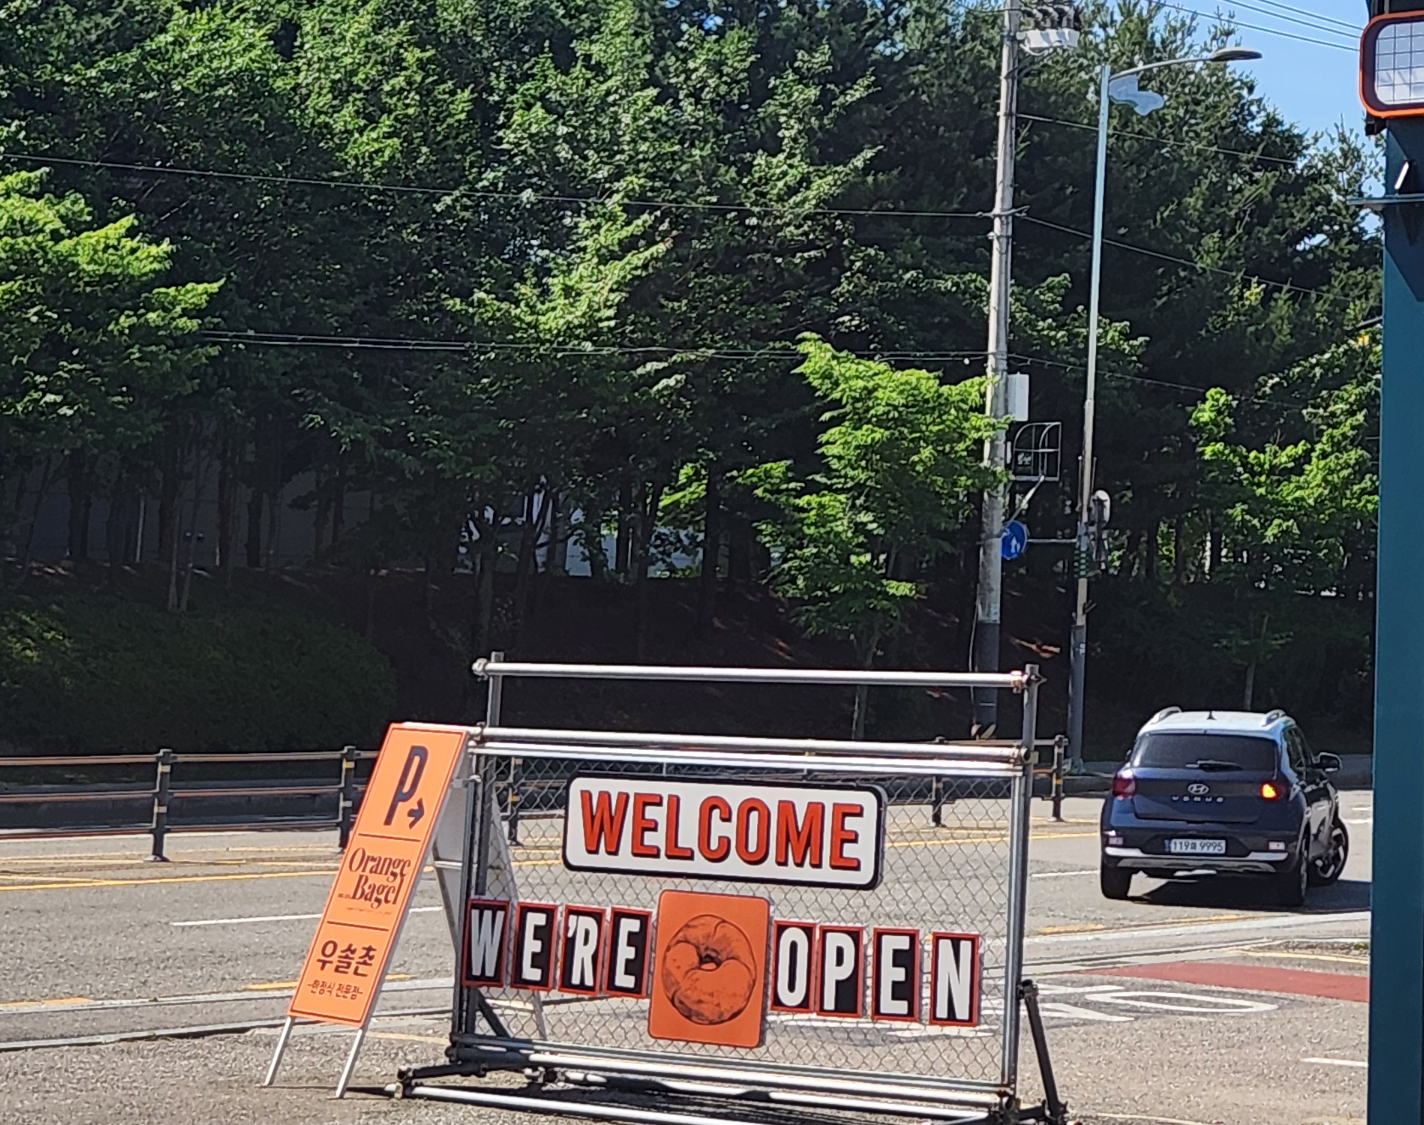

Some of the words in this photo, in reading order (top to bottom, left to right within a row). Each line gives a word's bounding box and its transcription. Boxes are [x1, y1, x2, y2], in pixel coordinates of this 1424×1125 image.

[383, 744, 430, 826] P
[580, 788, 866, 872] WELCOME
[348, 847, 411, 883] Orange
[352, 874, 405, 909] Bagel
[315, 939, 378, 978] 우솔촌
[470, 908, 642, 990] WE'RE
[776, 926, 971, 1021] OPEN
